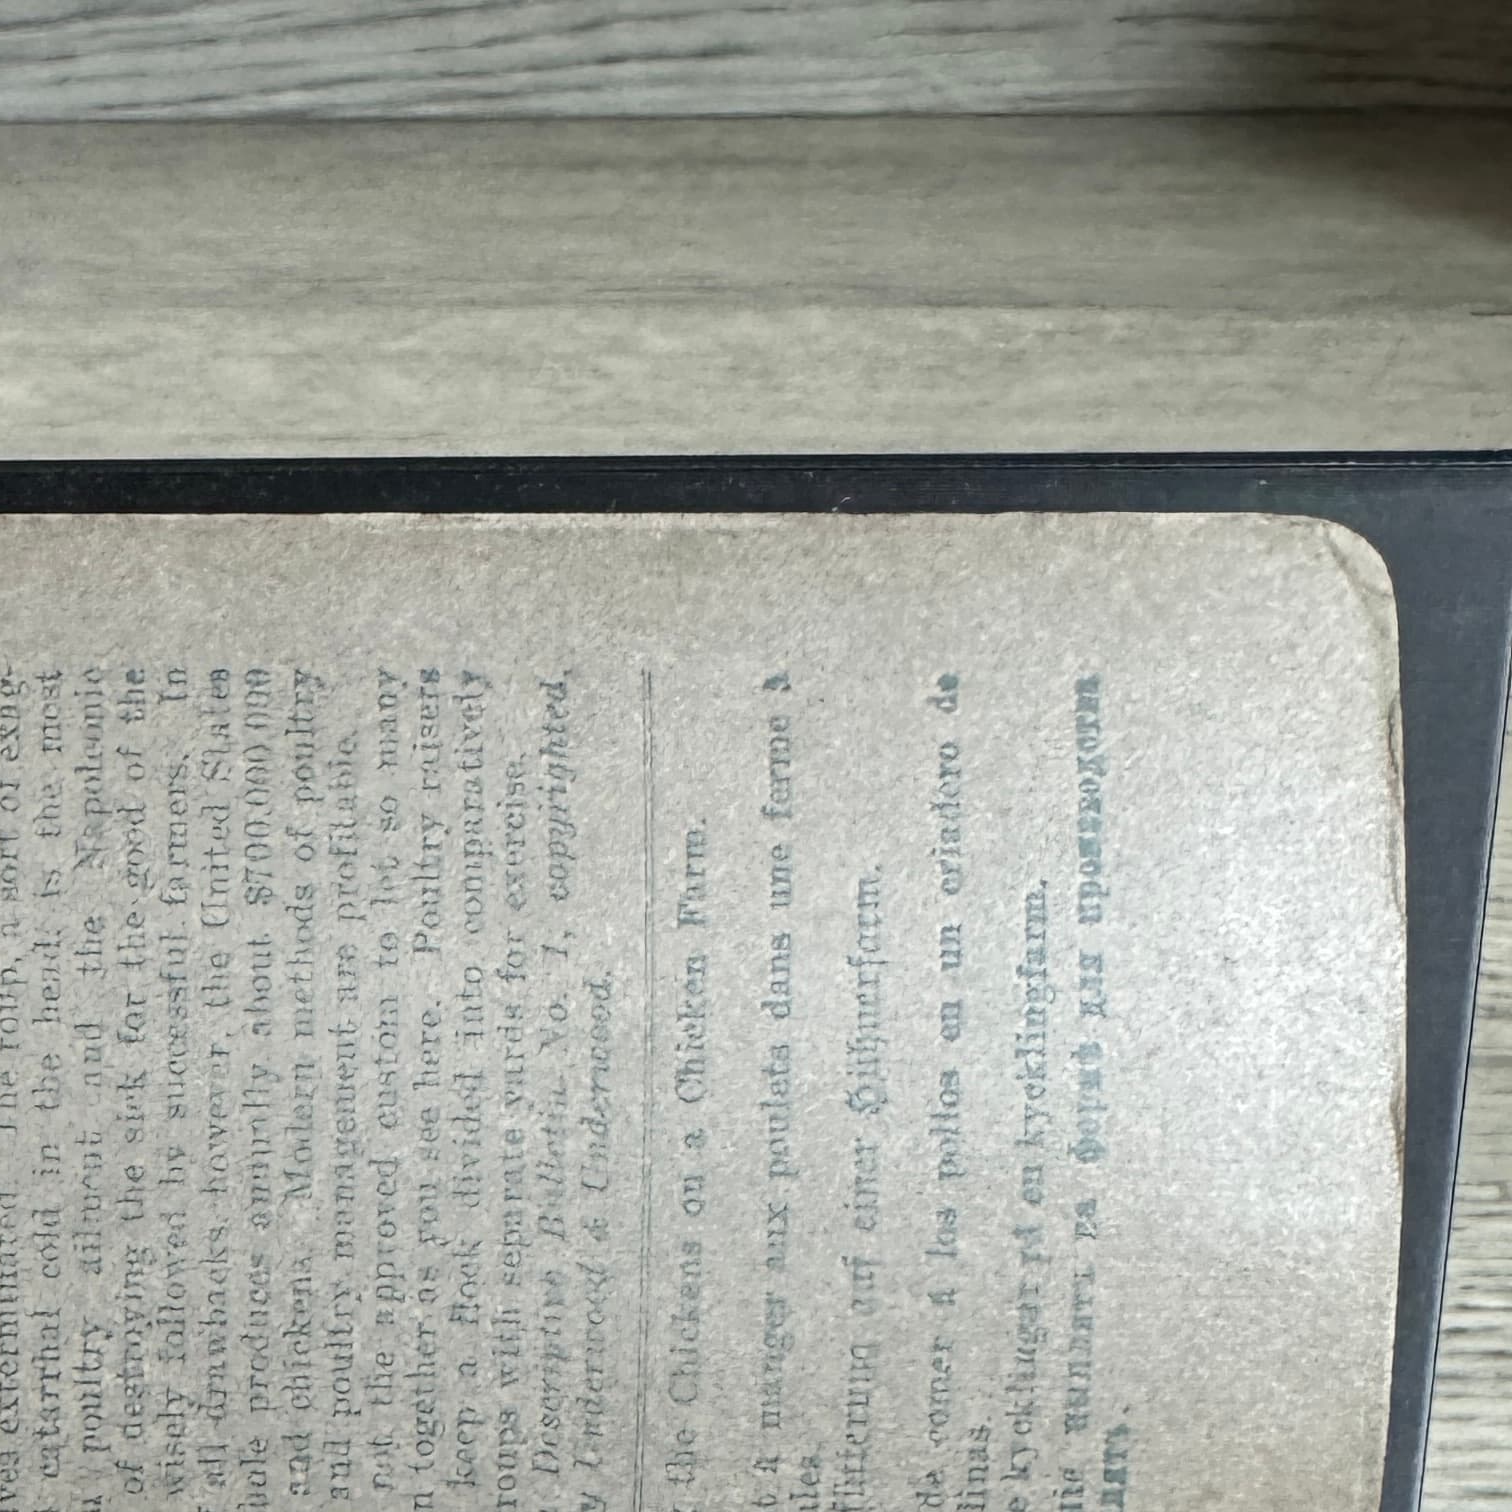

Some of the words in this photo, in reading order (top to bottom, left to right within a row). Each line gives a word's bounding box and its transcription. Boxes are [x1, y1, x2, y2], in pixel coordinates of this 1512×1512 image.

[35, 671, 62, 751] most
[117, 668, 145, 721] the
[159, 668, 186, 703] In
[377, 667, 406, 769] many
[927, 675, 958, 713] de
[117, 747, 144, 780] of
[286, 668, 324, 803] poultry
[415, 668, 440, 791] raisers
[457, 670, 491, 934] comparatively
[762, 717, 791, 821] ferme
[159, 755, 188, 905] farmers.
[288, 827, 313, 860] of
[380, 796, 397, 832] so
[931, 742, 960, 894] criadero
[412, 815, 448, 953] Poultry
[677, 819, 706, 928] Farm.
[769, 844, 789, 909] une
[117, 911, 144, 967] the
[288, 886, 313, 1036] methods
[374, 933, 397, 968] to
[762, 933, 789, 1018] dans
[938, 926, 960, 970] un
[202, 952, 230, 1006] the
[245, 938, 271, 1036] about
[457, 967, 482, 1046] into
[157, 934, 186, 1118] successful
[415, 1000, 440, 1088] here.
[676, 955, 706, 1103] Chicken
[939, 1000, 960, 1040] en
[33, 1054, 61, 1109] the
[117, 1070, 144, 1142] sick
[759, 1045, 798, 1177] poulets
[31, 1145, 60, 1174] in
[683, 1130, 702, 1147] a
[930, 1071, 965, 1179] pollos
[117, 1165, 143, 1220] the
[680, 1177, 704, 1216] on
[33, 1209, 60, 1277] cold
[927, 1209, 955, 1257] los
[324, 1282, 360, 1417] poultry
[670, 1241, 702, 1404] Chickens
[27, 1309, 61, 1479] catarrhal
[76, 1316, 110, 1451] poultry
[368, 1353, 394, 1404] the
[410, 1322, 443, 1472] together
[114, 1461, 143, 1493] of
[324, 1440, 349, 1498] and
[446, 1411, 478, 1487] keep
[666, 1430, 695, 1483] the
[918, 1471, 944, 1506] de
